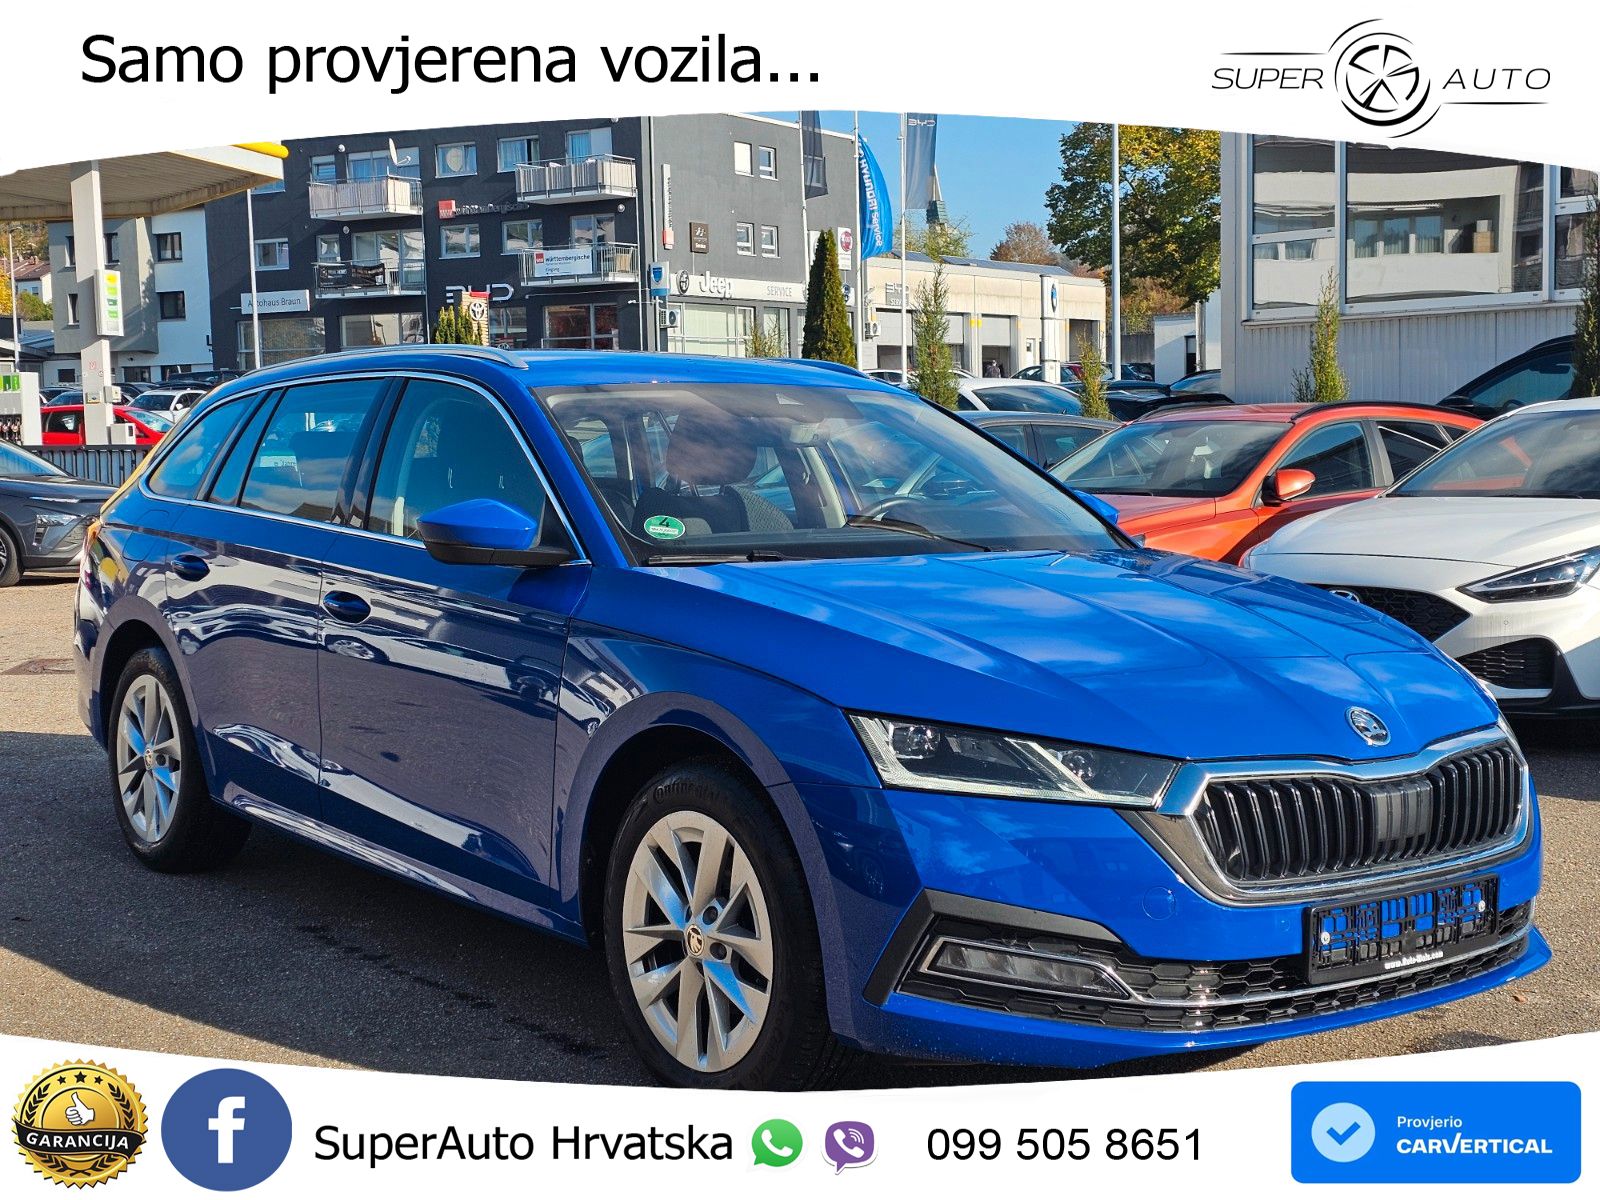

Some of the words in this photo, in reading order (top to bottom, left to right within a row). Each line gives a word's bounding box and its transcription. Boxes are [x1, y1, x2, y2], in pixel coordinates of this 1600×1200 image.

[860, 158, 878, 210] HYUNDAI
[700, 270, 734, 300] Jeep
[766, 285, 793, 298] SERVICE
[247, 299, 280, 307] Atohaus
[281, 297, 301, 306] Braun
[658, 517, 671, 528] 4
